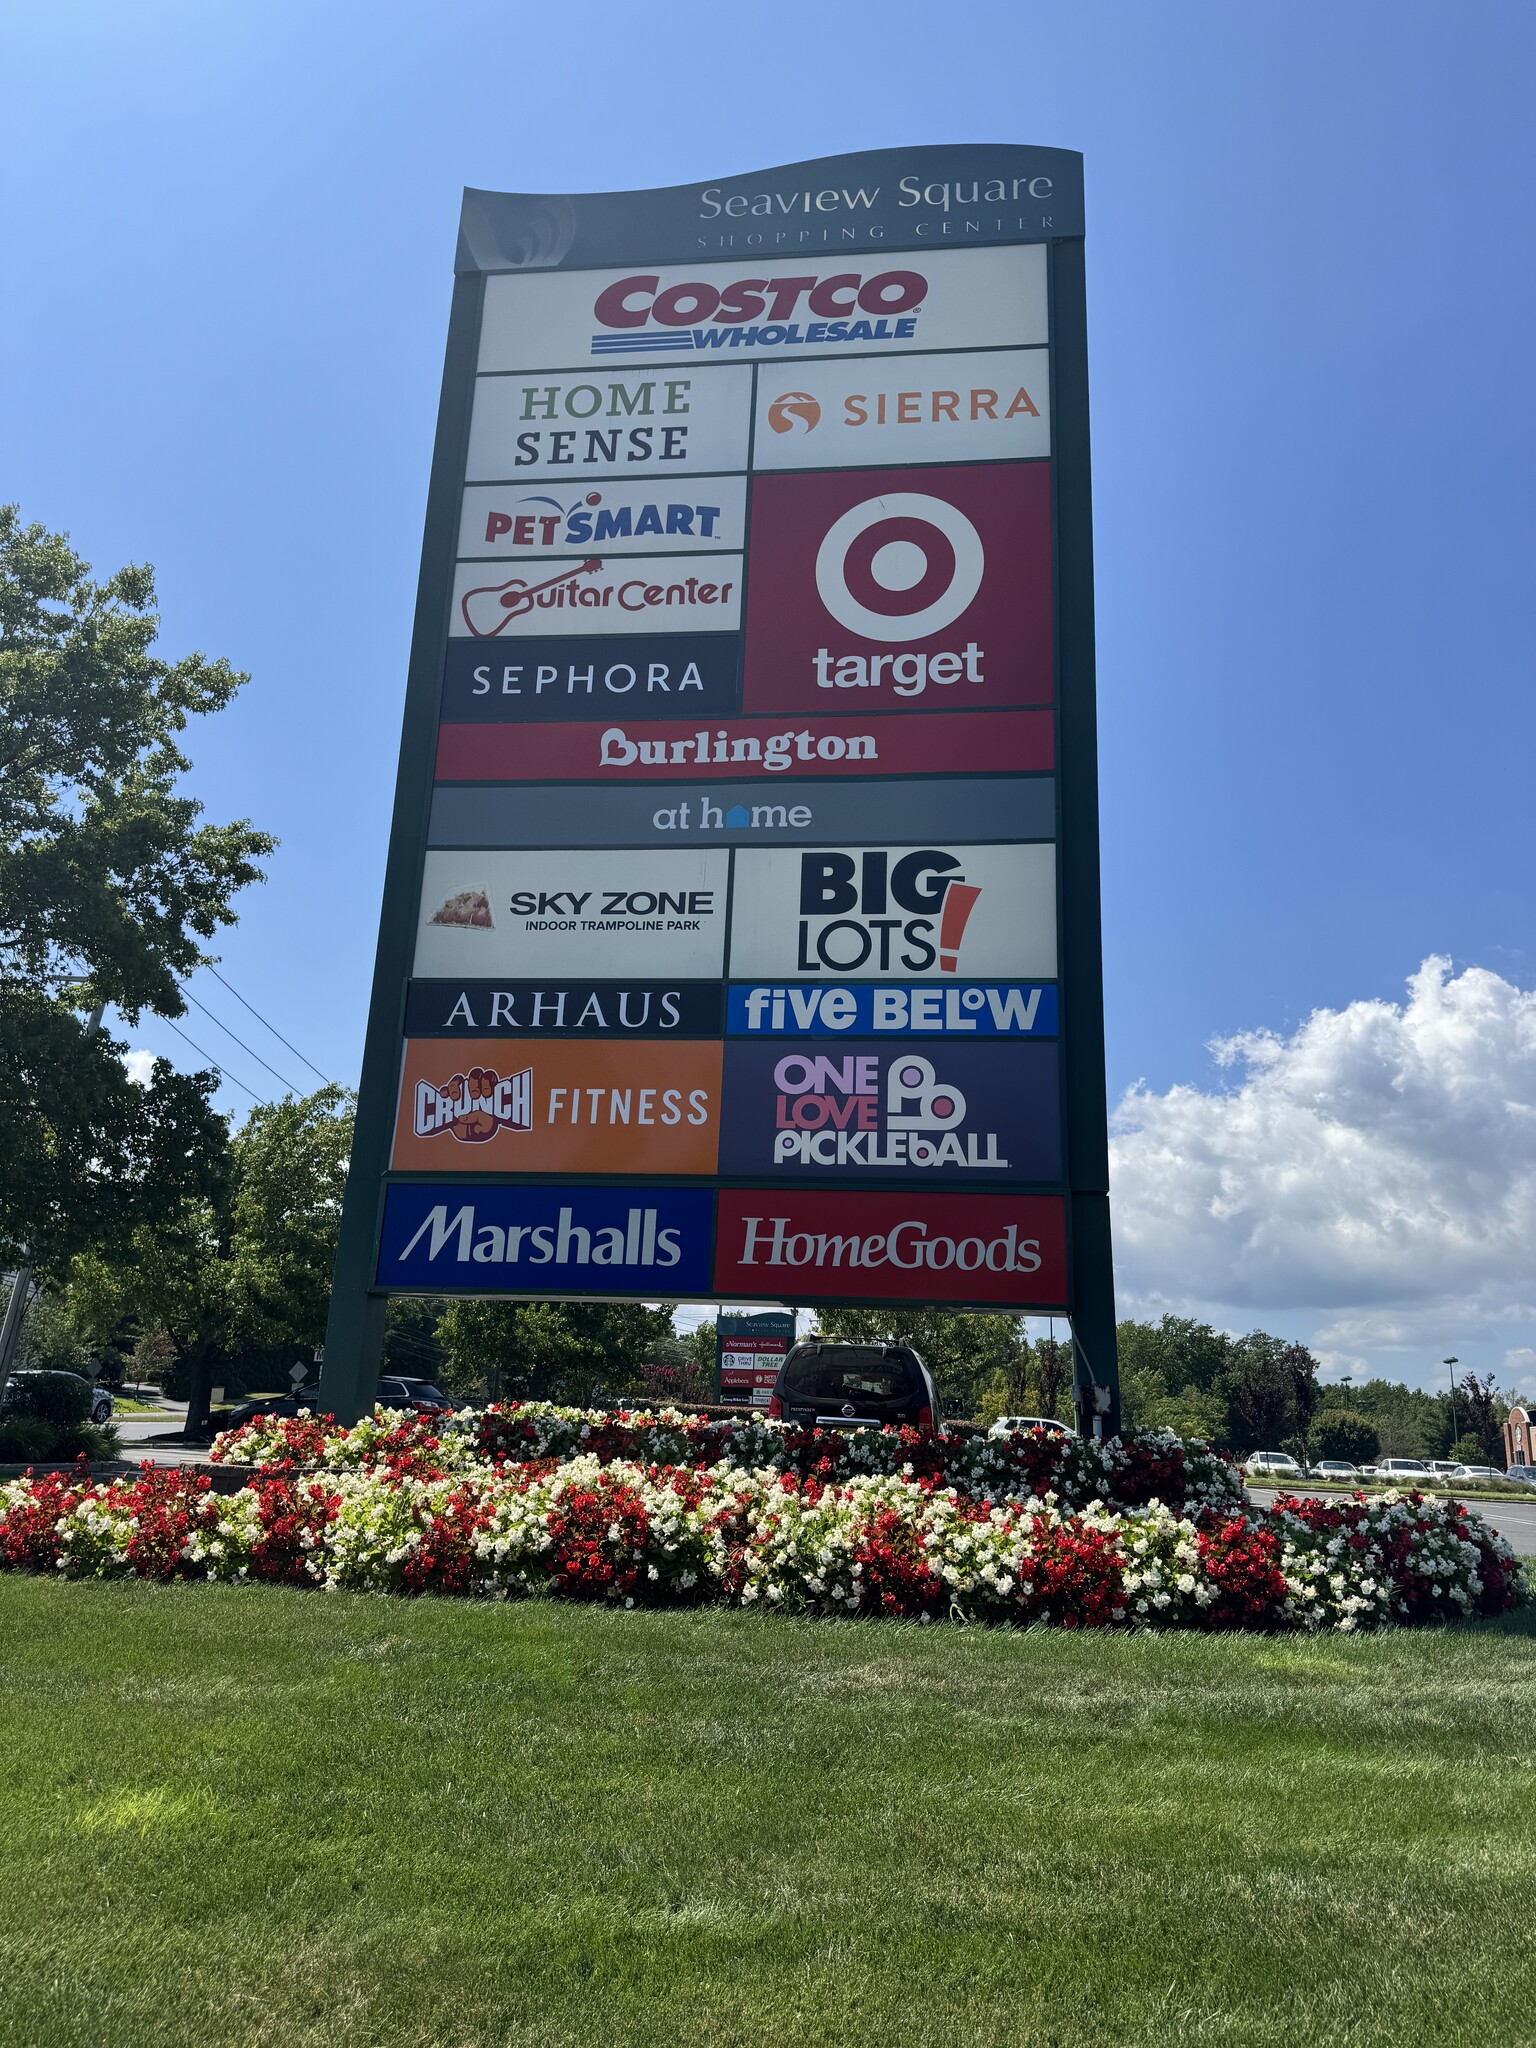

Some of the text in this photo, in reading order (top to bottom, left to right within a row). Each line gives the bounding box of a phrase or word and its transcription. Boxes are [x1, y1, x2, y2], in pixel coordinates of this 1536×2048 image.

[699, 175, 1054, 220] Seaview Square
[697, 215, 1054, 249] SHOPPING CENTER
[593, 269, 929, 329] COSTCO
[692, 317, 918, 350] WHOLESALE
[518, 380, 692, 421] HOME
[843, 386, 1041, 427] SIERRA
[514, 426, 688, 466] SENSE
[617, 577, 733, 612] Center
[471, 661, 705, 695] SEPHORA
[812, 642, 985, 697] target
[599, 727, 879, 771] Burlington
[652, 802, 691, 830] at
[509, 891, 714, 916] SKY ZONE
[799, 850, 966, 916] BIG
[525, 920, 701, 932] INDOOR TRAMPOLINE PARK
[442, 991, 681, 1027] ARHAUS
[773, 1054, 879, 1095] ONE
[415, 1068, 709, 1136] CRUNCH FITNESS
[775, 1094, 879, 1130] LOVE
[398, 1205, 682, 1266] Marshalls
[736, 1216, 1042, 1273] HomeGoods
